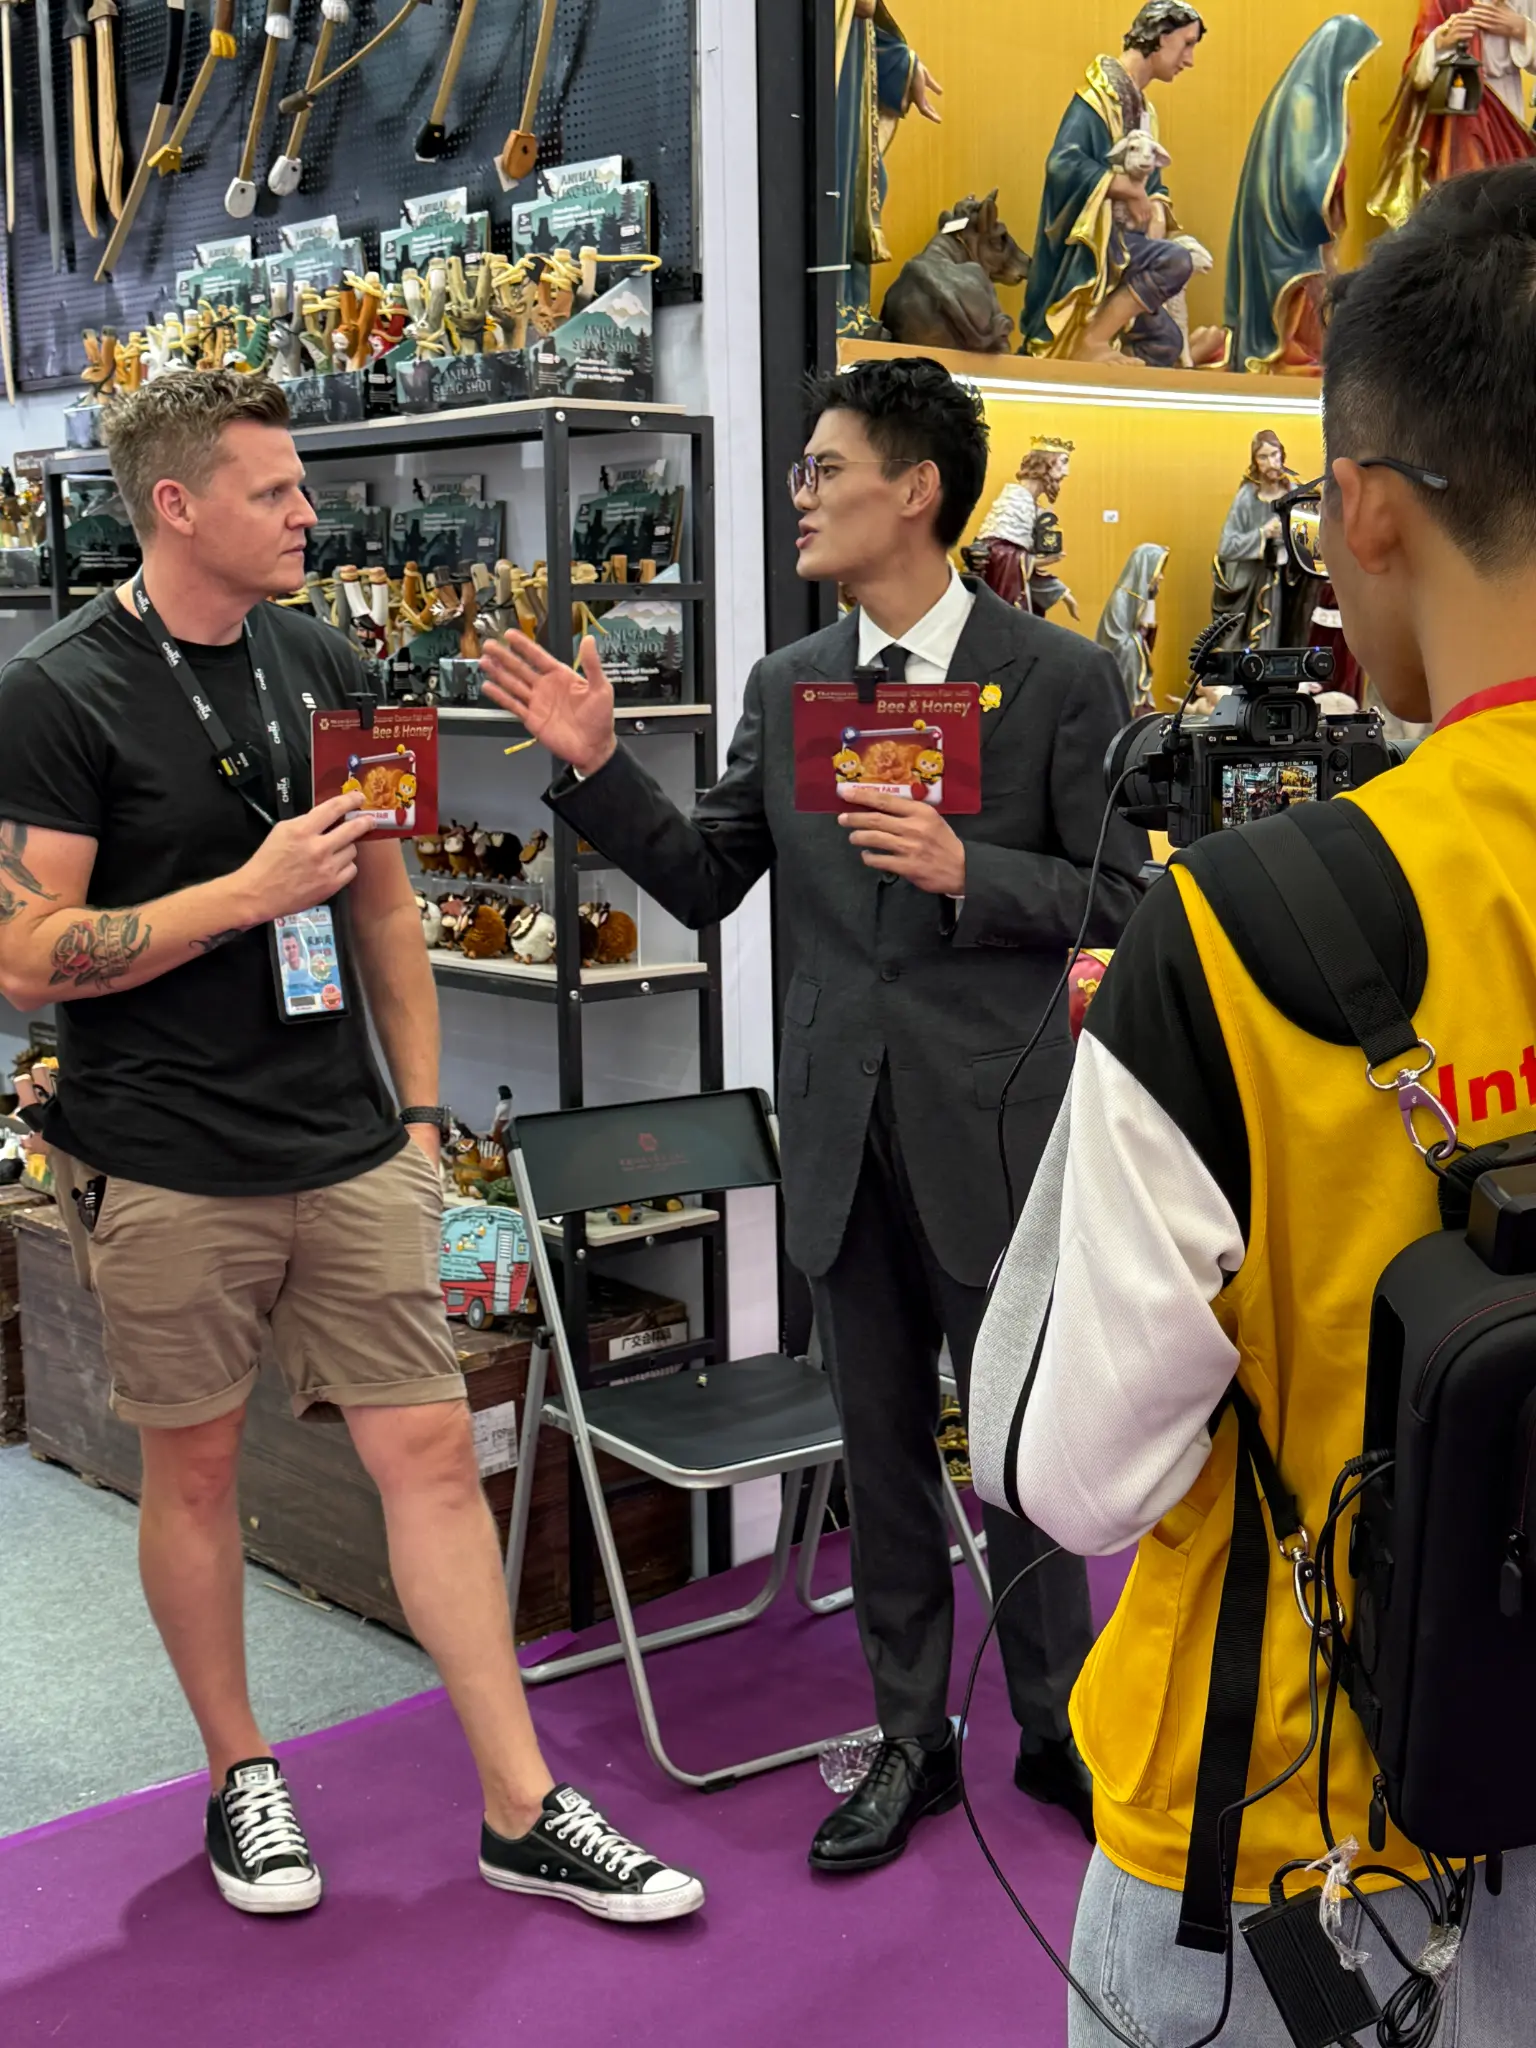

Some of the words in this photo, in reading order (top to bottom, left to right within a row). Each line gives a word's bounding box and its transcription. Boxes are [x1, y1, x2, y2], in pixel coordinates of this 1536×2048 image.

[584, 324, 628, 340] ANIMAL
[611, 341, 641, 354] SHOT
[445, 367, 482, 382] ANIMAL
[465, 379, 493, 394] SHOT
[162, 641, 179, 667] CHINA
[598, 641, 630, 655] LING
[631, 641, 667, 655] SHOT
[193, 695, 210, 720] CHINA
[876, 700, 906, 713] Bee
[908, 699, 918, 713] &
[921, 699, 971, 717] Honey
[372, 726, 392, 739] Bee
[393, 725, 401, 738] &
[402, 725, 434, 741] Honey
